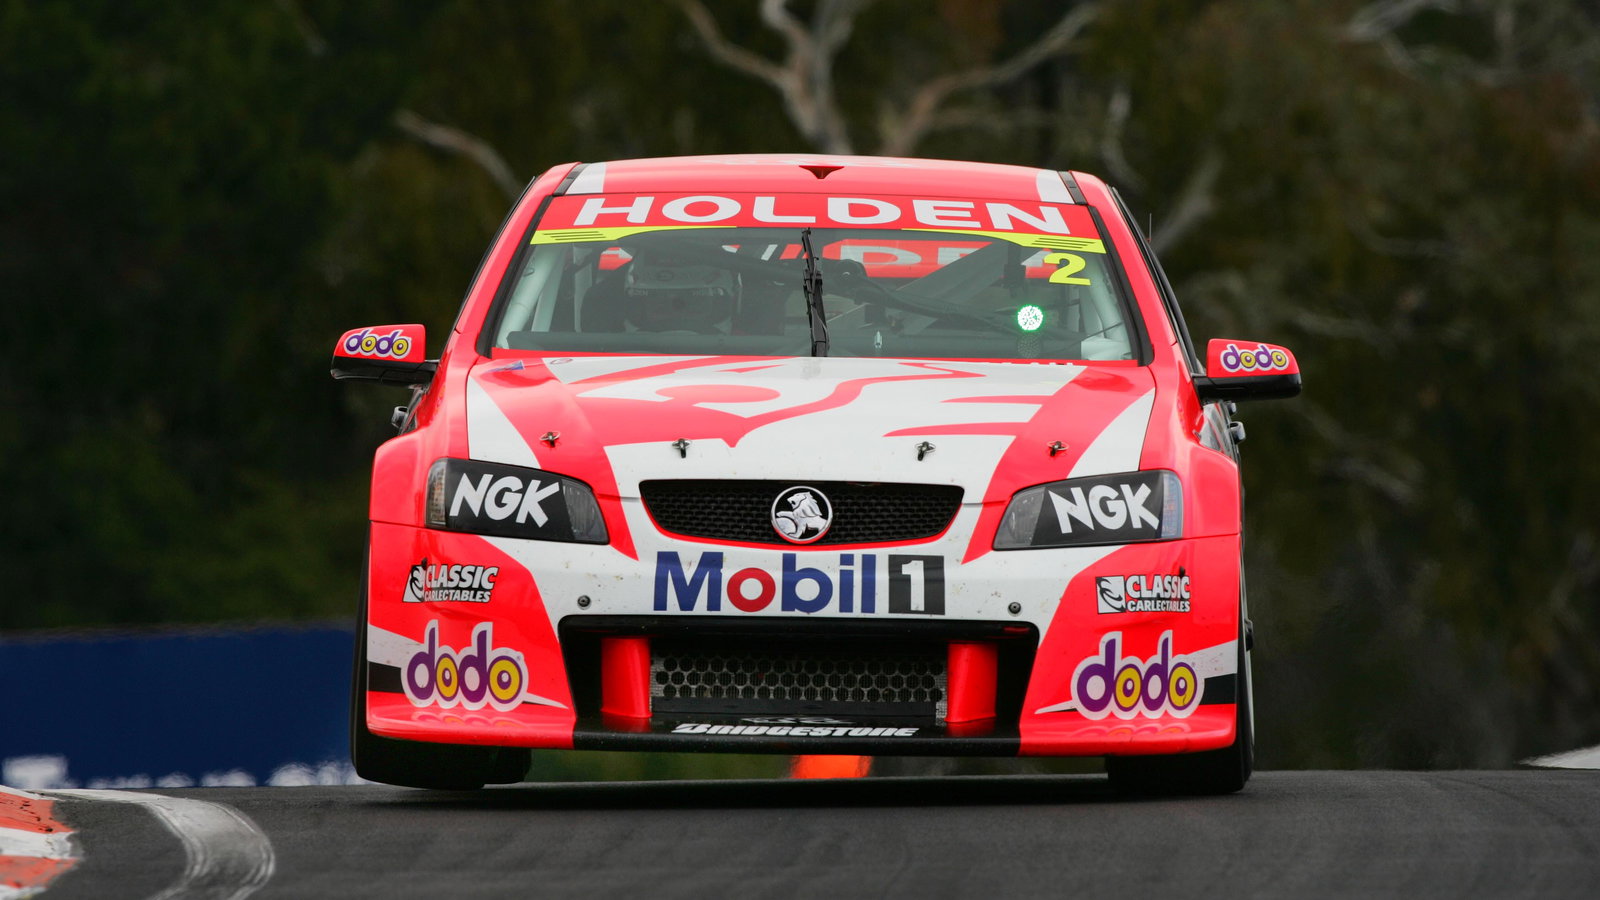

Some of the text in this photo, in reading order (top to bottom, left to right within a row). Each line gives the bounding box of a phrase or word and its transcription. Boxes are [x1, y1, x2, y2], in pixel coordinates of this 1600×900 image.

[573, 195, 1070, 235] HOLDEN
[1043, 252, 1092, 286] 2
[344, 329, 410, 357] dodo
[1222, 344, 1288, 370] dodo
[449, 472, 559, 528] NGK
[1048, 482, 1160, 534] NGK
[425, 564, 499, 590] CLASSIC
[653, 551, 925, 614] Mobil 1
[1125, 575, 1190, 600] CLASSIC
[424, 589, 491, 603] CARLECTABLES
[1126, 600, 1191, 613] CARLECTABLES
[405, 625, 524, 706] dodo
[1075, 635, 1199, 713] dodo
[671, 723, 920, 737] BRIDGESTONE
